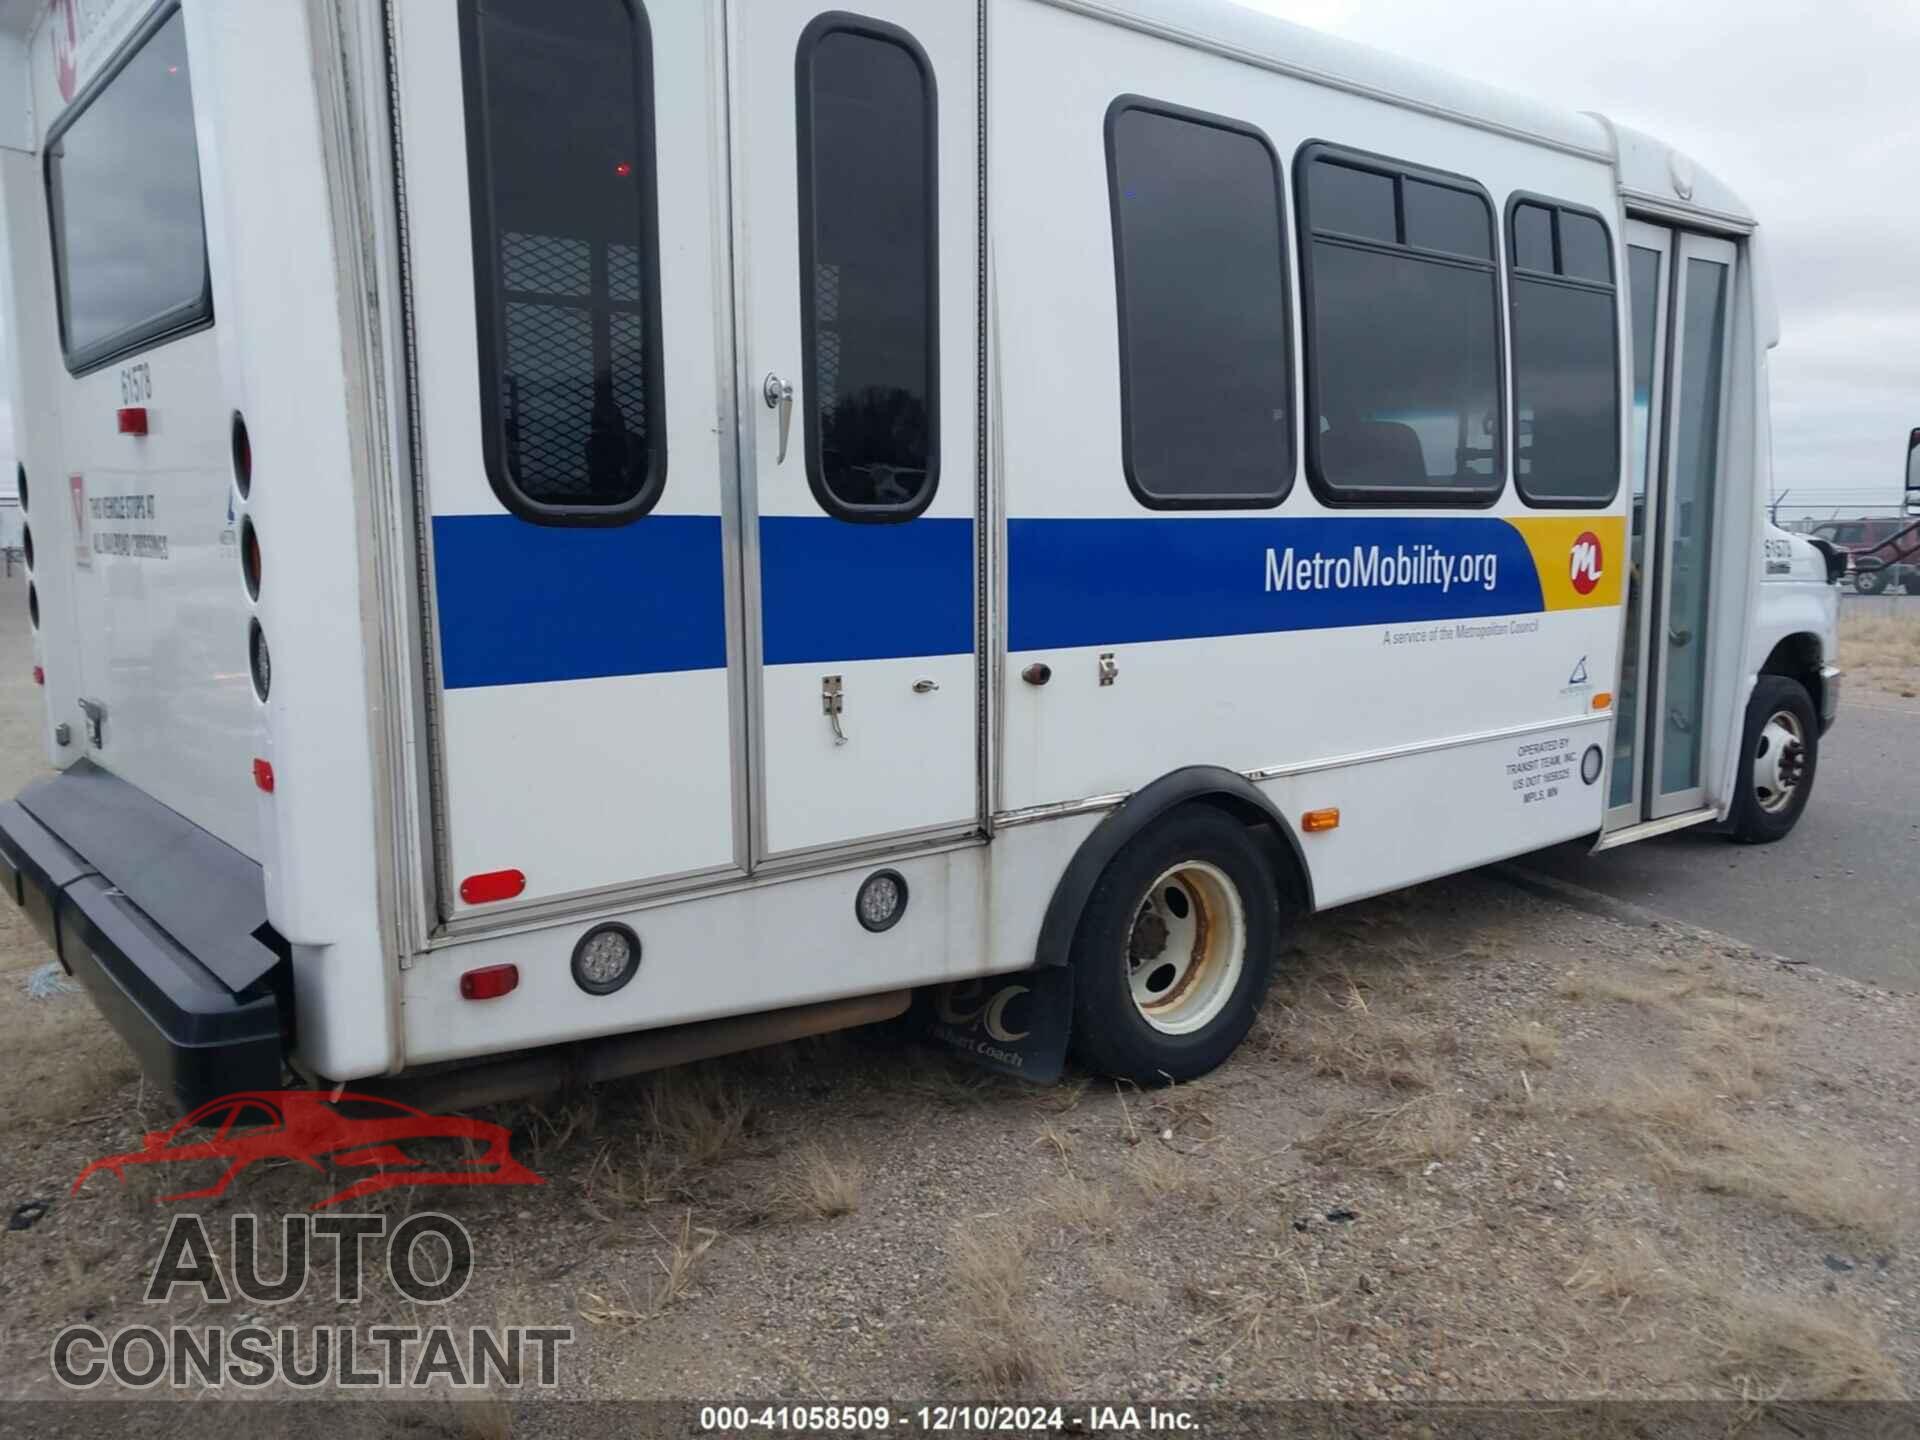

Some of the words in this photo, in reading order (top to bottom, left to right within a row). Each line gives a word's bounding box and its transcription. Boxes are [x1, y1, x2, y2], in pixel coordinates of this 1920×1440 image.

[1265, 545, 1497, 592] MetroMobility.org
[1382, 630, 1391, 645] A
[1393, 631, 1427, 644] service
[1429, 627, 1439, 642] of
[1440, 627, 1453, 640] the
[1456, 623, 1508, 640] Metropolitan
[1510, 618, 1539, 634] Council
[1518, 739, 1557, 757] OPERATED
[1559, 737, 1569, 749] BY
[1505, 759, 1539, 776] TRANSIT
[1512, 778, 1525, 791] US
[1526, 774, 1541, 788] DOT
[977, 1042, 1024, 1068] Coach
